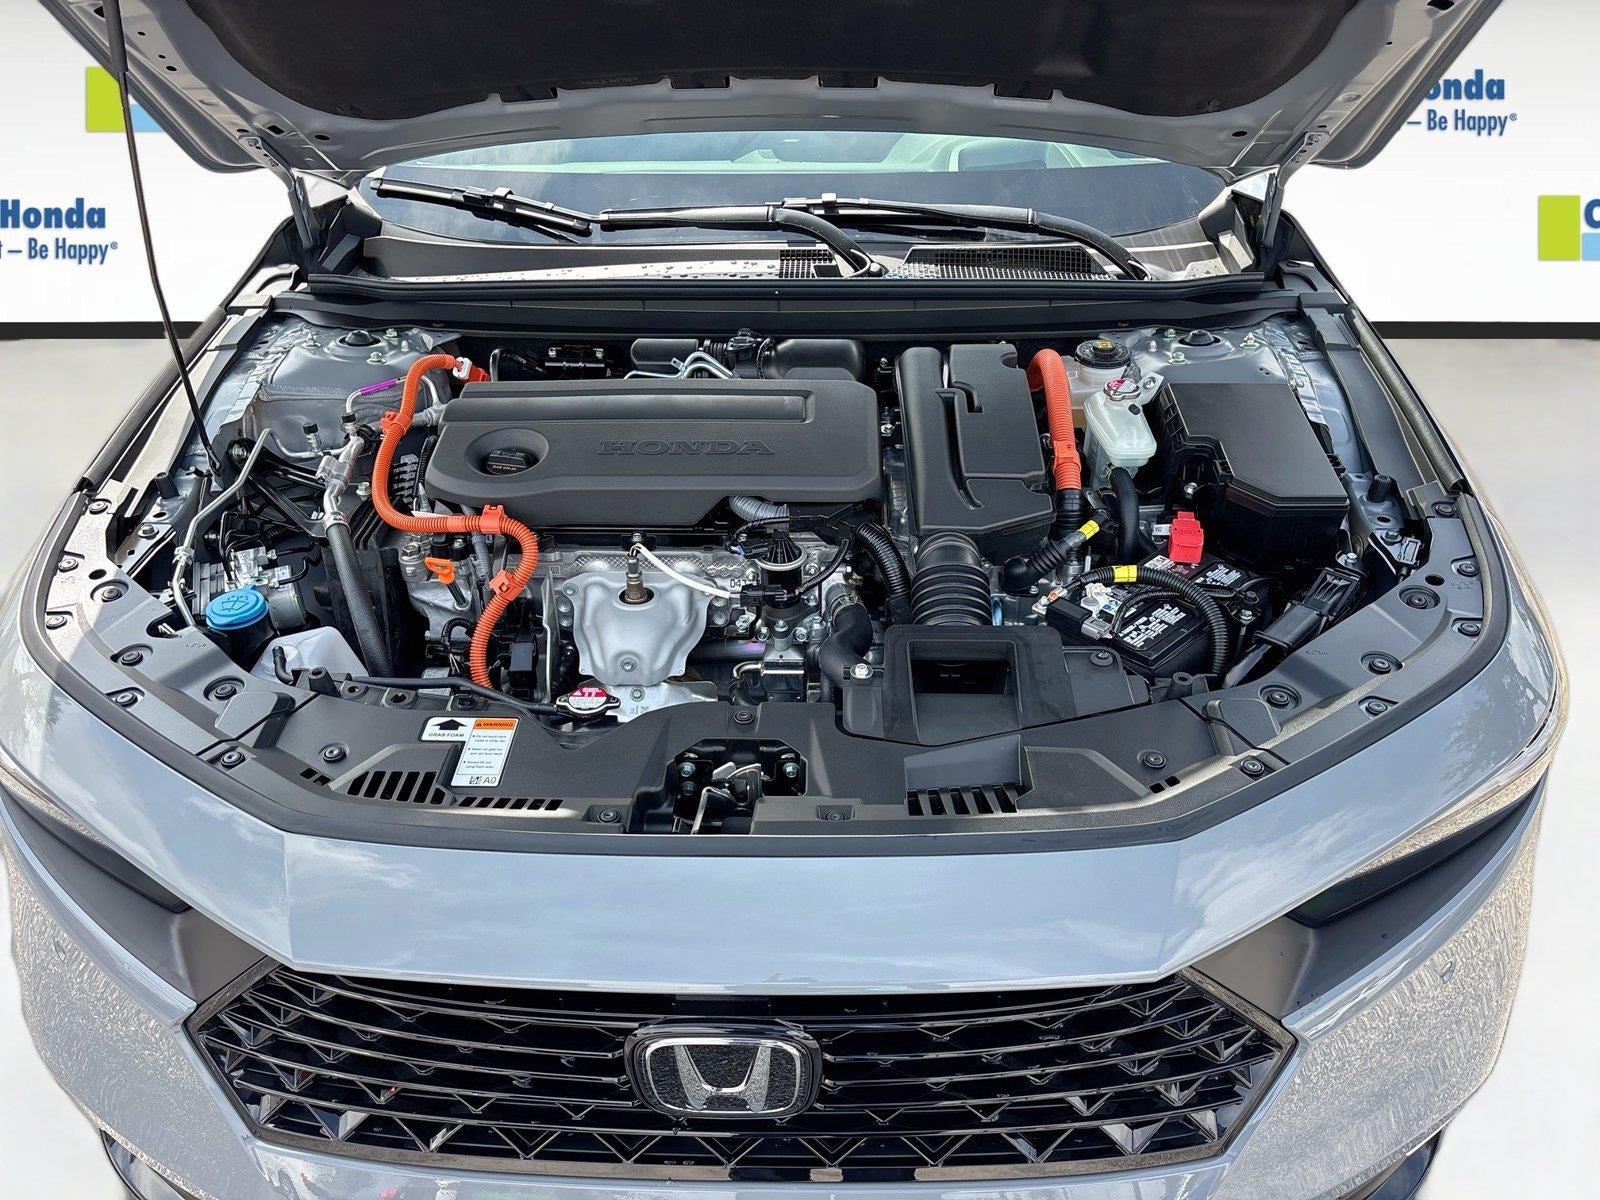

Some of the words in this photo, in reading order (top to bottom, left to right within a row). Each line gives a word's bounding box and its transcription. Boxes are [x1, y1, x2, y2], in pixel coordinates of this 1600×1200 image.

[1427, 109, 1448, 131] Be
[0, 197, 106, 229] Honda
[28, 237, 49, 260] Be
[597, 440, 776, 455] HONDA
